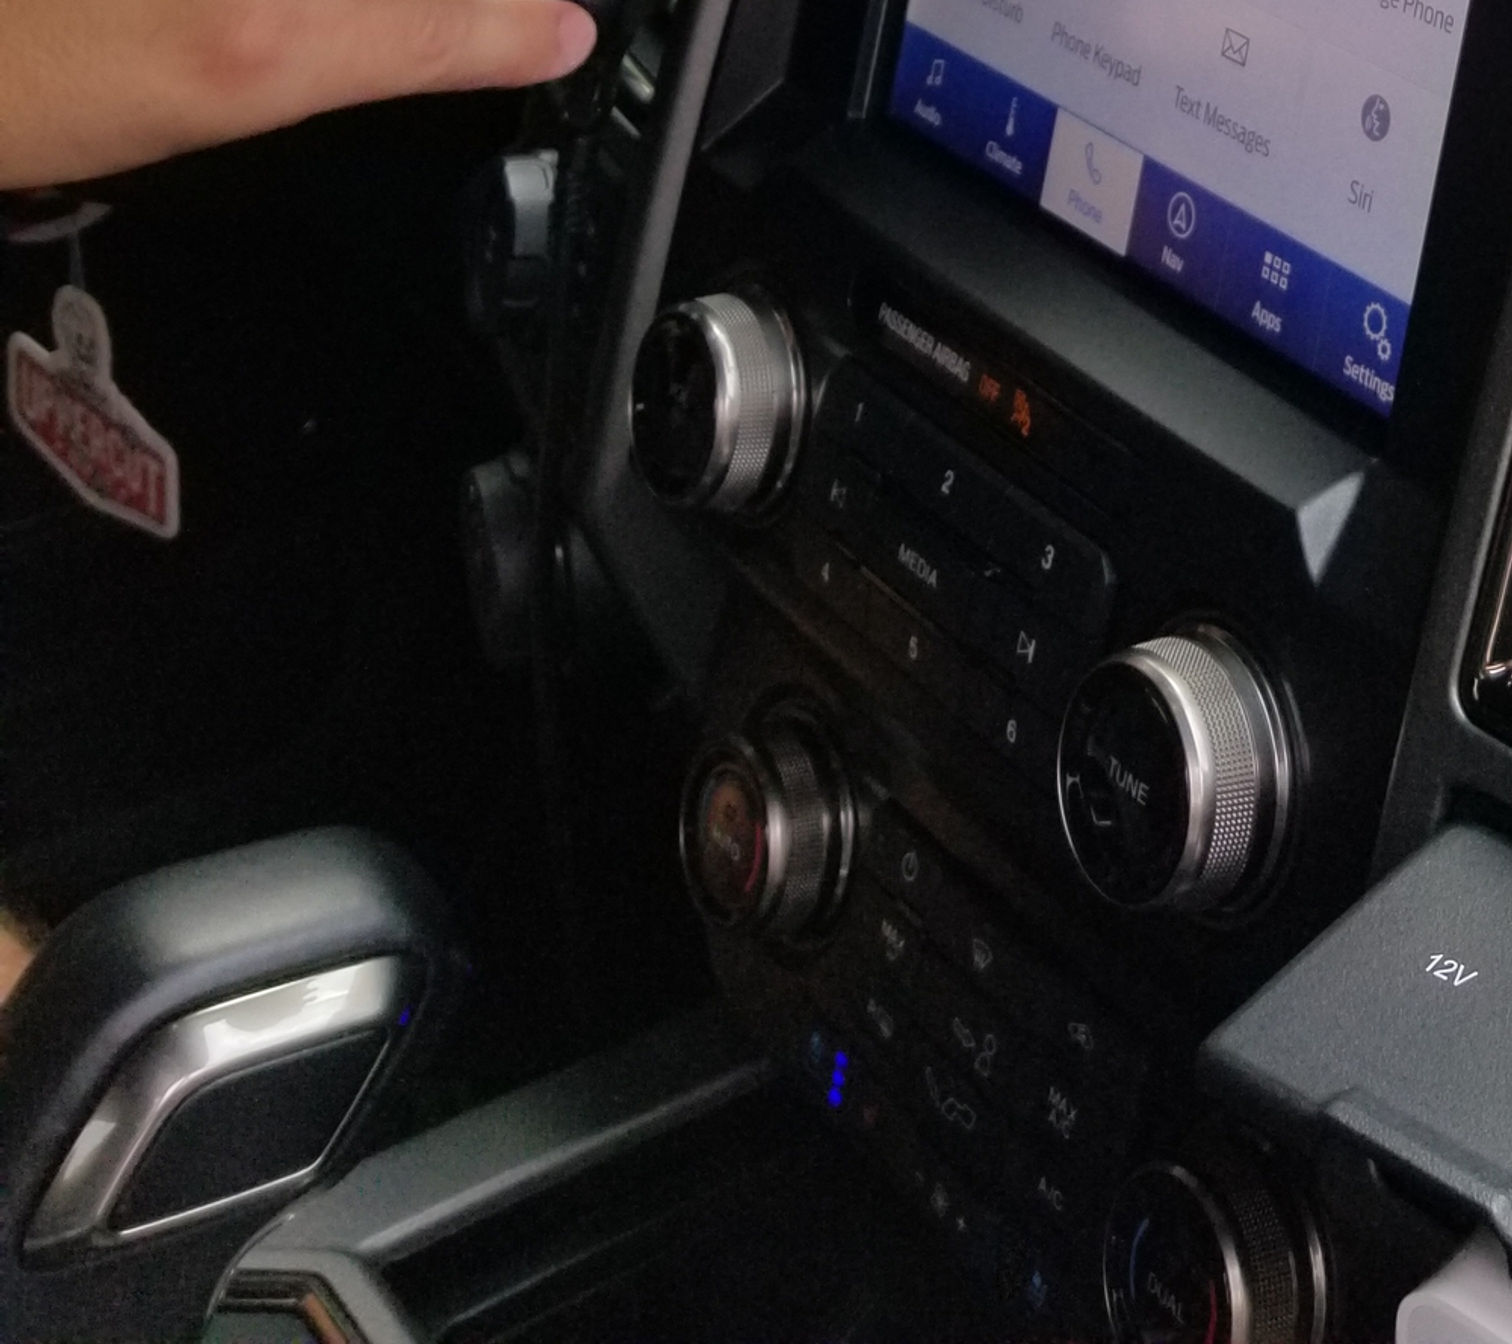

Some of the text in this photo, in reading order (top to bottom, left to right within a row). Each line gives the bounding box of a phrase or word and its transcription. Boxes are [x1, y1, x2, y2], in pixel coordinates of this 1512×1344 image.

[1050, 21, 1142, 87] Phone Keypad
[1173, 84, 1272, 158] Text Messages
[1066, 188, 1104, 226] Phone
[1347, 179, 1376, 214] Siri
[1161, 244, 1185, 273] Nav
[1251, 299, 1283, 334] Apps
[877, 302, 936, 359] PASSENGER
[932, 341, 972, 383] AIRBAG
[1343, 354, 1395, 403] Settings
[940, 469, 955, 494] 2
[898, 542, 938, 589] MEDIA
[1041, 543, 1056, 570] 3
[1006, 718, 1018, 743] 6
[1110, 754, 1150, 806] TUNE
[1423, 950, 1479, 989] 12V
